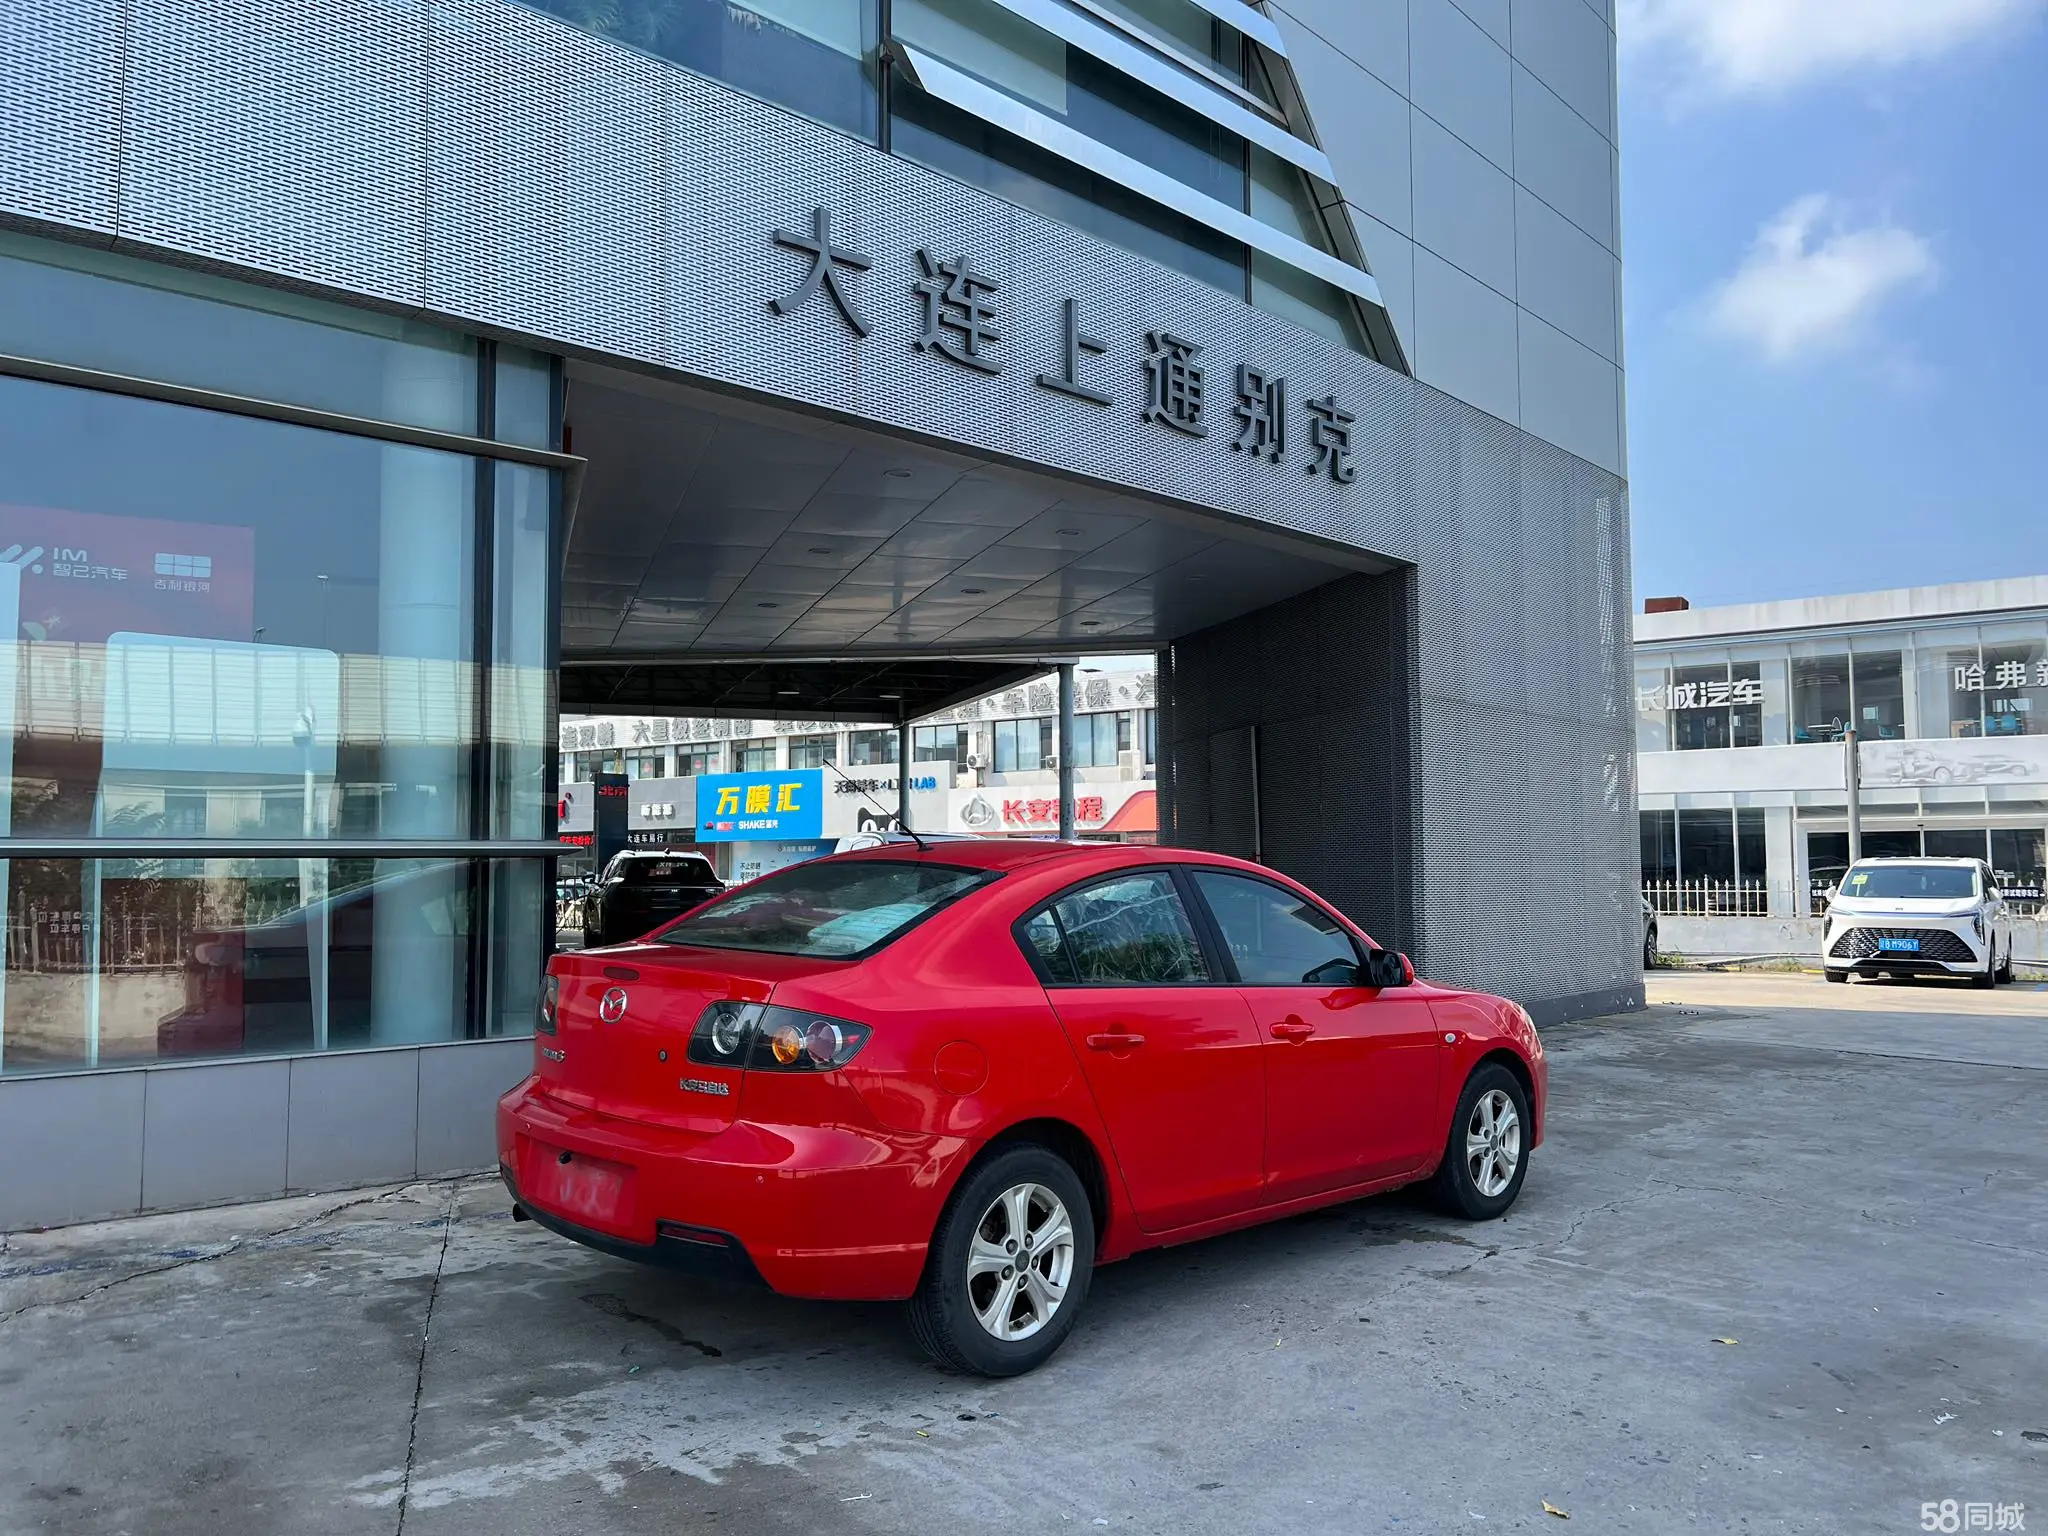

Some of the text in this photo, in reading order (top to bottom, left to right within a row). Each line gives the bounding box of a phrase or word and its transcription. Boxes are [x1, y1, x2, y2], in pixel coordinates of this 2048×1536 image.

[768, 207, 1356, 484] 大连上通别克
[53, 547, 87, 563] IM
[53, 563, 128, 581] 智己汽车
[154, 579, 210, 593] 吉利银河
[1636, 679, 1764, 711] 长城汽车
[914, 776, 936, 789] LAB
[716, 783, 802, 815] 万膜汇
